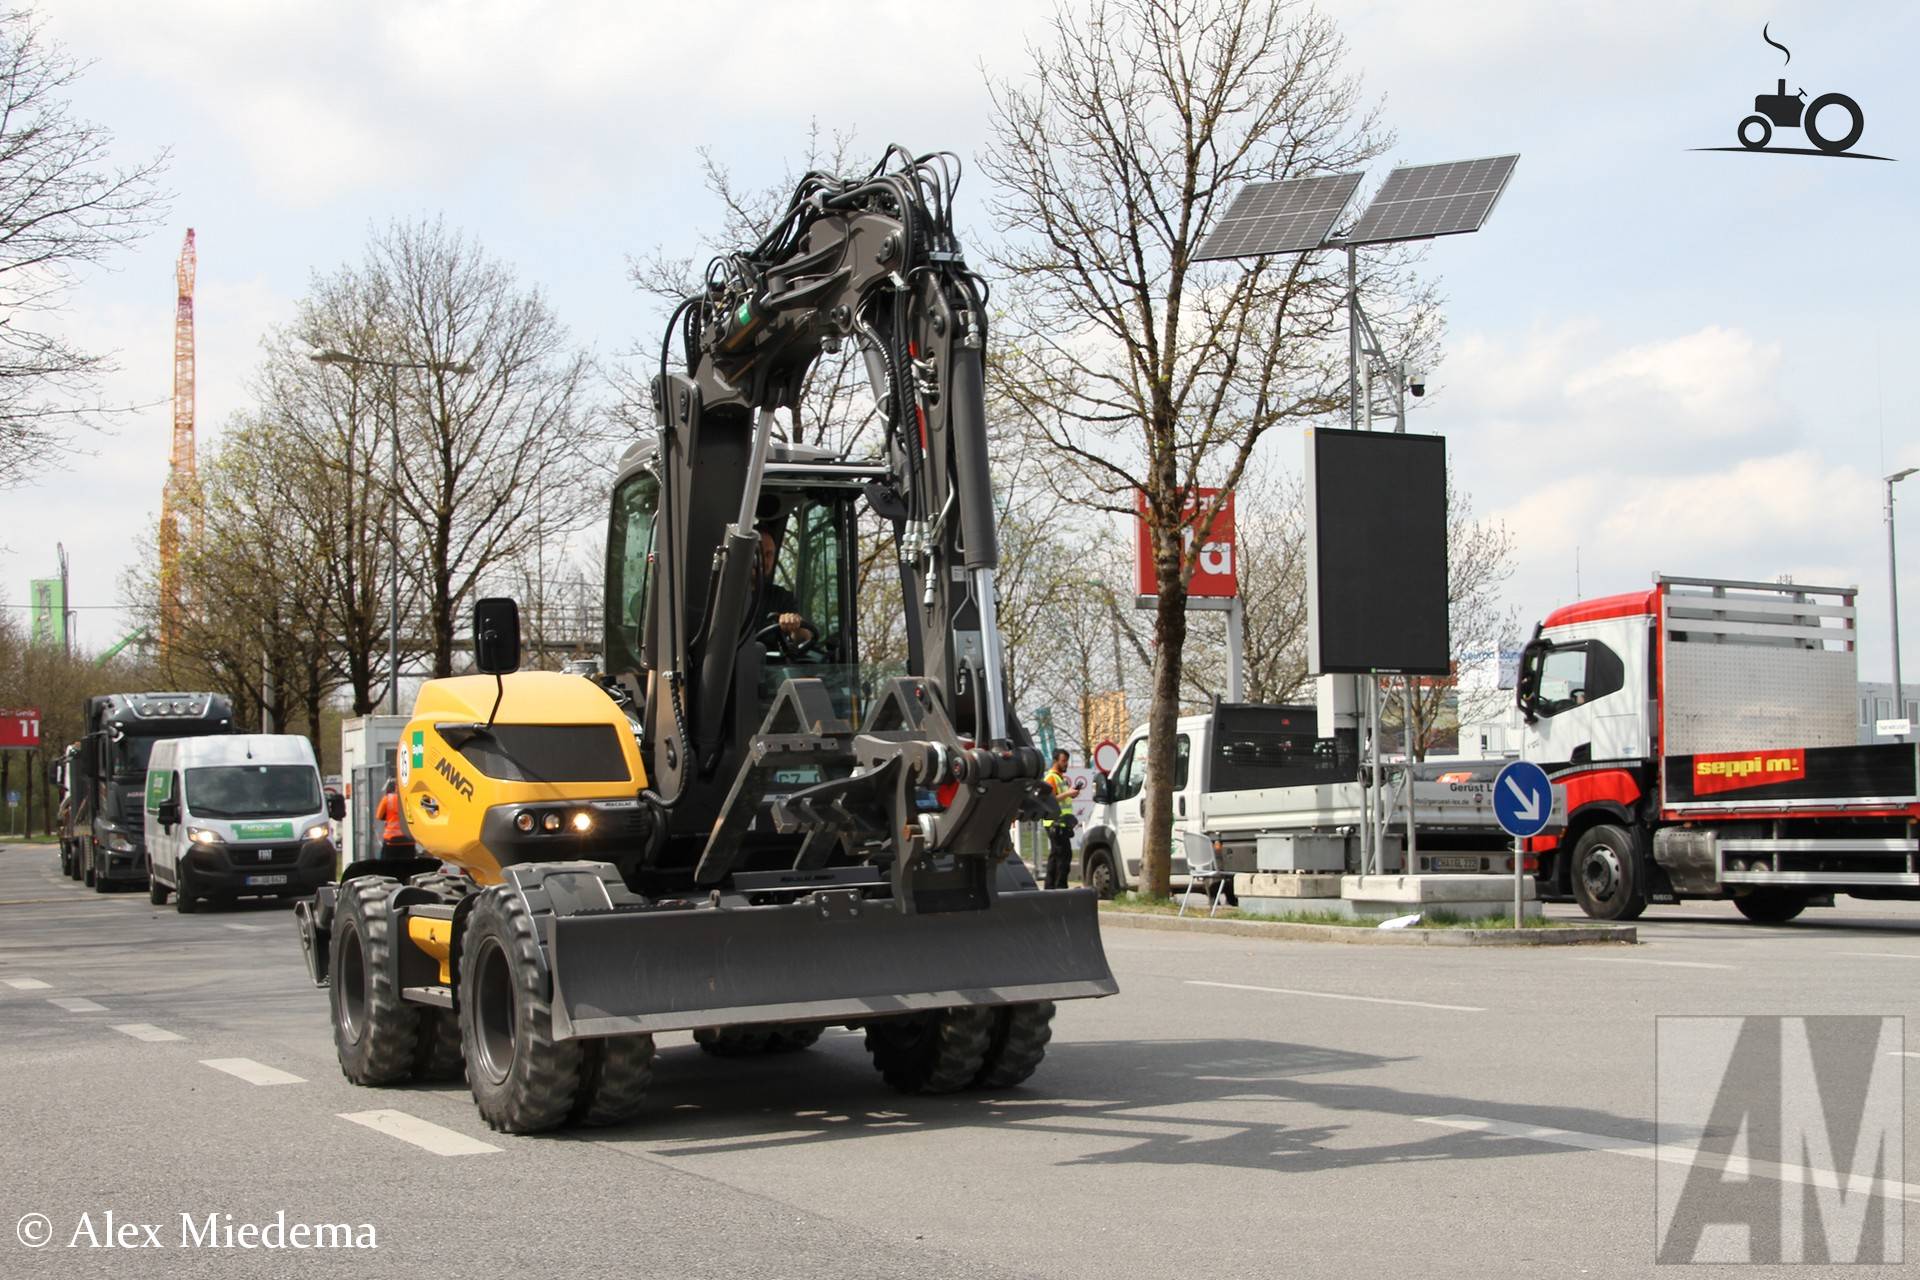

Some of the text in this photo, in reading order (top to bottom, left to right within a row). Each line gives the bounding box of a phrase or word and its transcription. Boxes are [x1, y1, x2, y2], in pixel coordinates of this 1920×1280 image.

[19, 720, 39, 737] 11
[1696, 756, 1763, 778] seppi
[434, 756, 474, 803] MWR
[258, 849, 272, 861] FIAT
